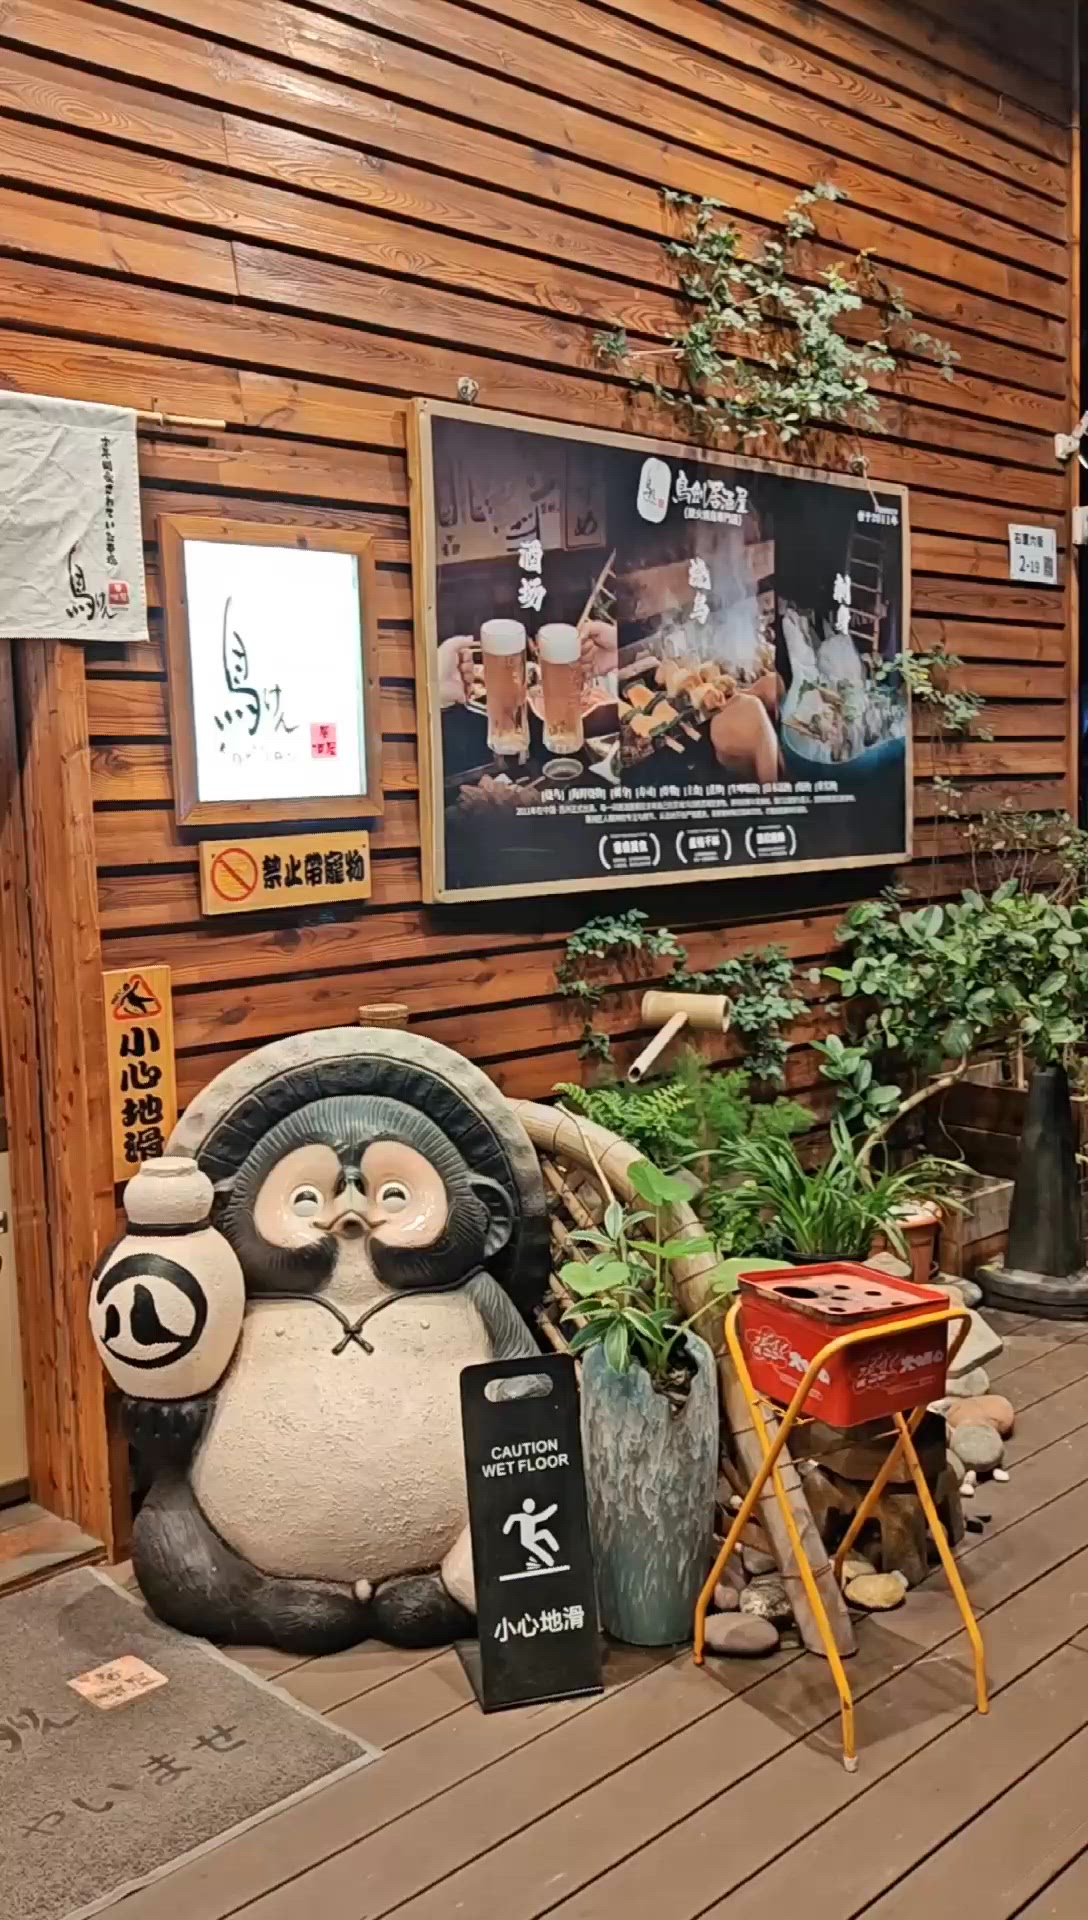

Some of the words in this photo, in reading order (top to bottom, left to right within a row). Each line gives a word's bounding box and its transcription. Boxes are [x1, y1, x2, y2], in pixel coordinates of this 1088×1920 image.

[119, 1026, 165, 1163] 小心地滑
[482, 1459, 516, 1478] WET
[517, 1453, 570, 1473] FLOOR
[491, 1438, 559, 1461] CAUTION
[494, 1604, 585, 1643] 小心地滑
